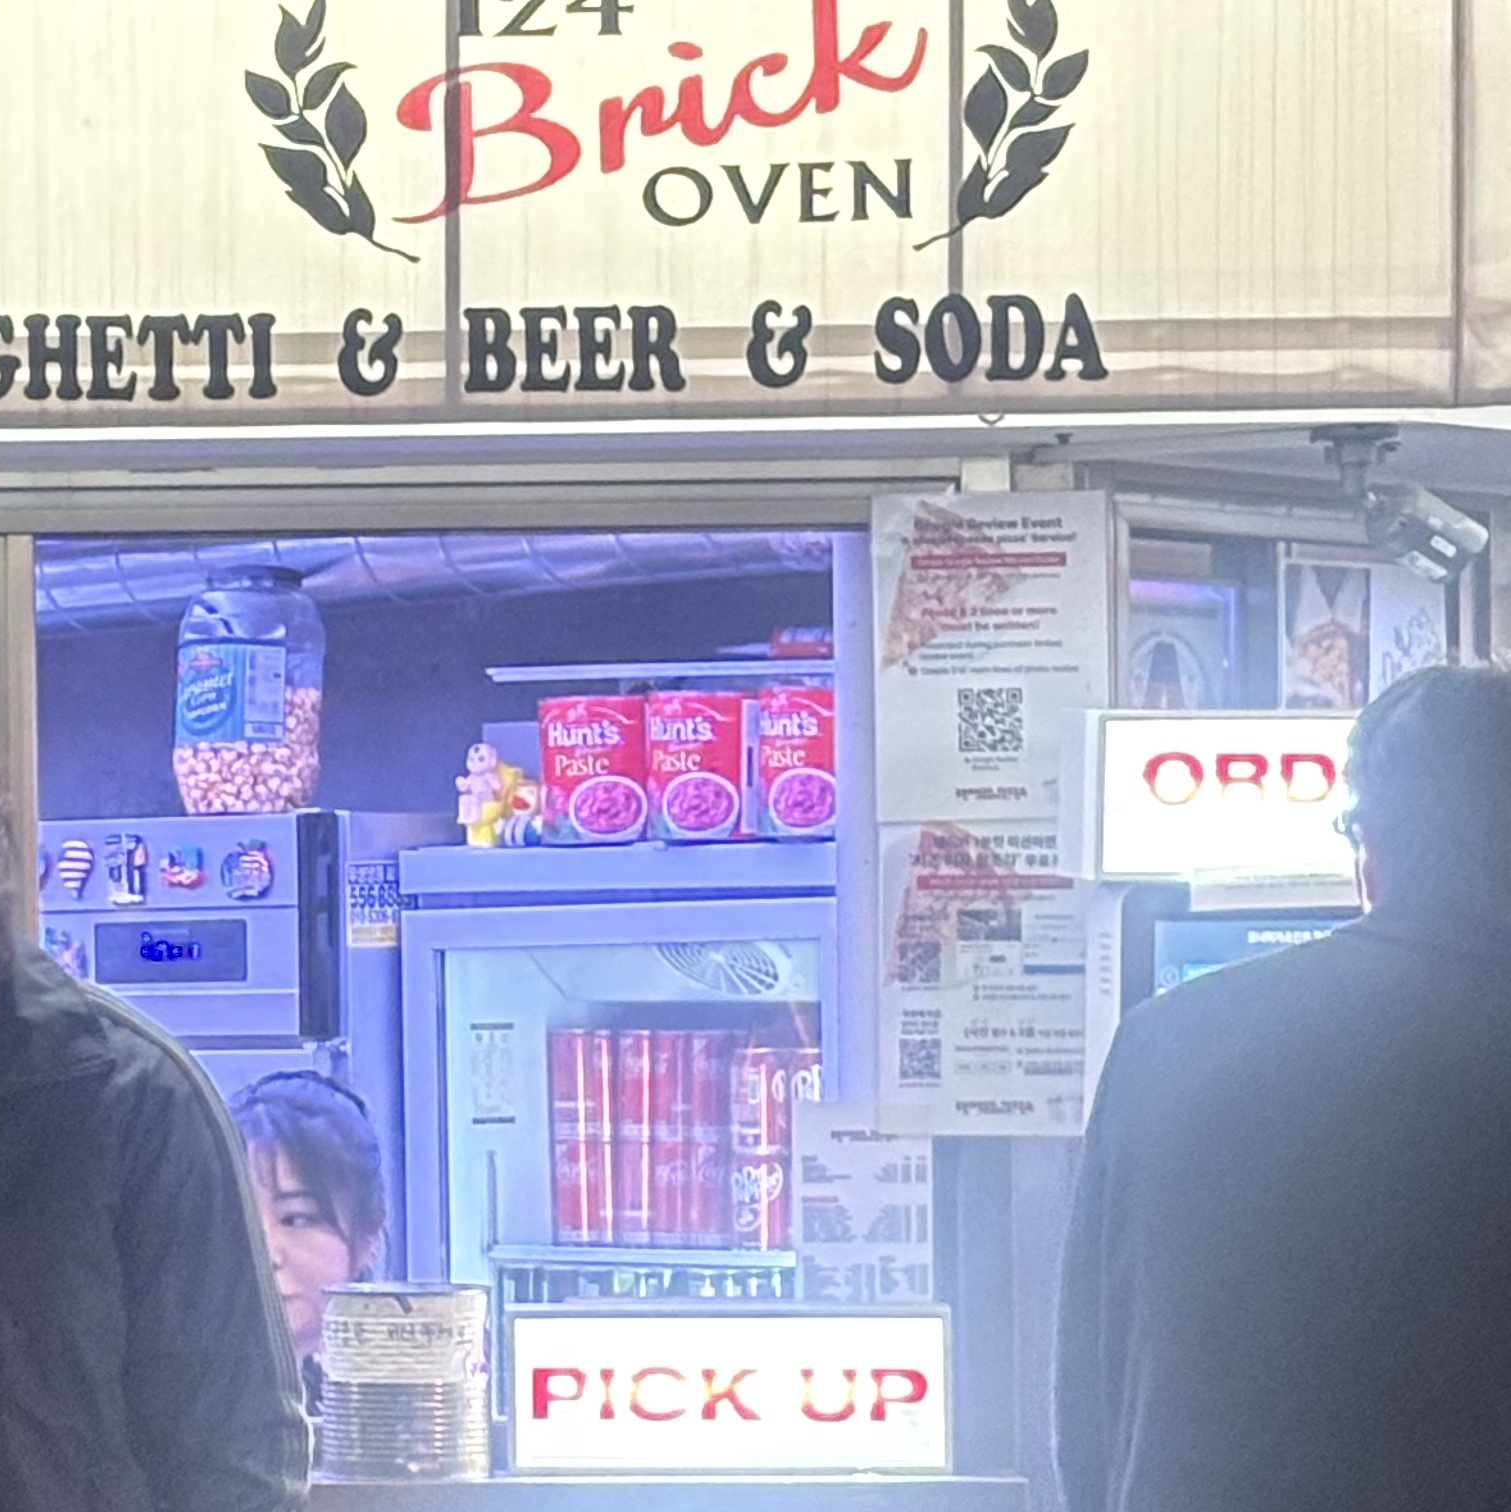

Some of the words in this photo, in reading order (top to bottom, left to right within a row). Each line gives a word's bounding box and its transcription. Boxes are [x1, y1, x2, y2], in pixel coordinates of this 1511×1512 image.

[393, 0, 927, 223] Brick
[642, 158, 913, 227] OVEN
[338, 308, 402, 396] &
[464, 304, 686, 394] BEER
[746, 300, 811, 388] &
[875, 293, 1108, 383] SODA
[1021, 516, 1063, 529] Event
[547, 719, 621, 748] Hunt's
[650, 715, 714, 743] Hunt's
[554, 753, 610, 777] Paste
[652, 748, 702, 773] Paste
[1142, 750, 1341, 805] ORD
[531, 1366, 762, 1422] PICK
[800, 1367, 929, 1423] UP
